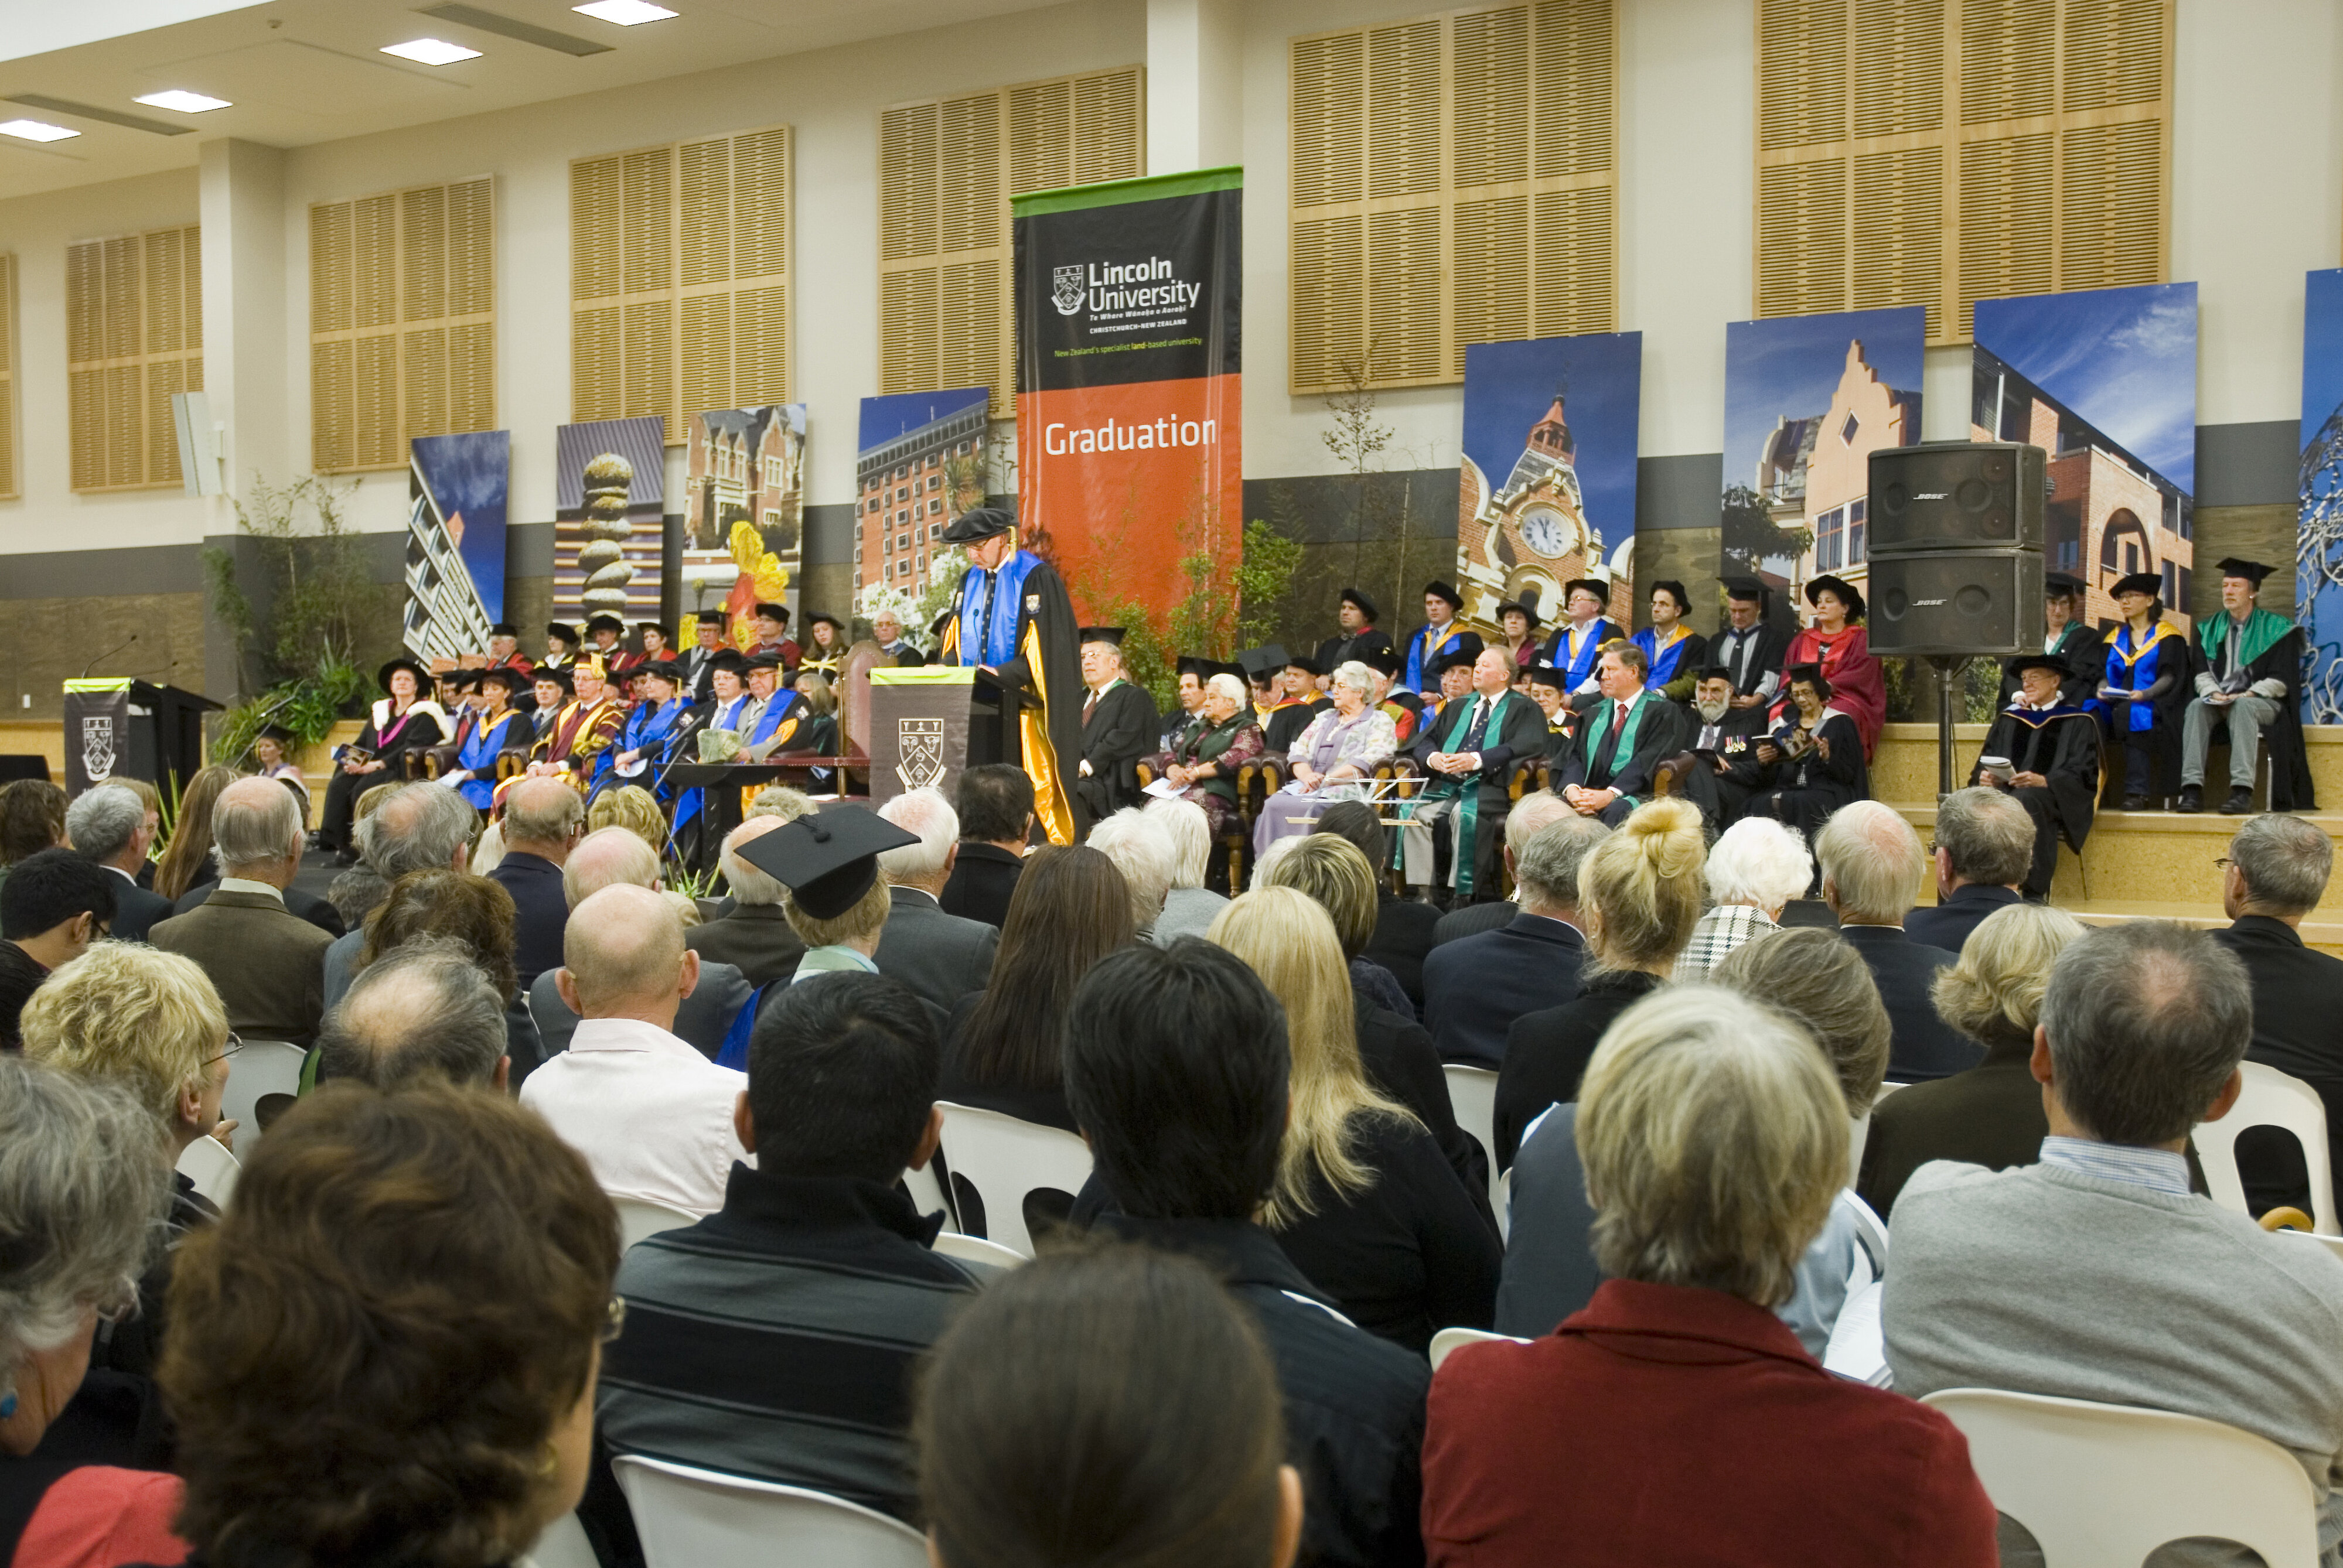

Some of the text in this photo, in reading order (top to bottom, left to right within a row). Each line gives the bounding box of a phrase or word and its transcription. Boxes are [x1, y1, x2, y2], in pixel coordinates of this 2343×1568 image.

[1089, 256, 1172, 286] Lincoln
[1089, 279, 1201, 312] University
[1157, 319, 1187, 327] ZEALAND
[1101, 343, 1130, 354] specialist
[1131, 339, 1167, 350] land-based
[1168, 337, 1202, 347] university
[1045, 414, 1216, 456] Graduation
